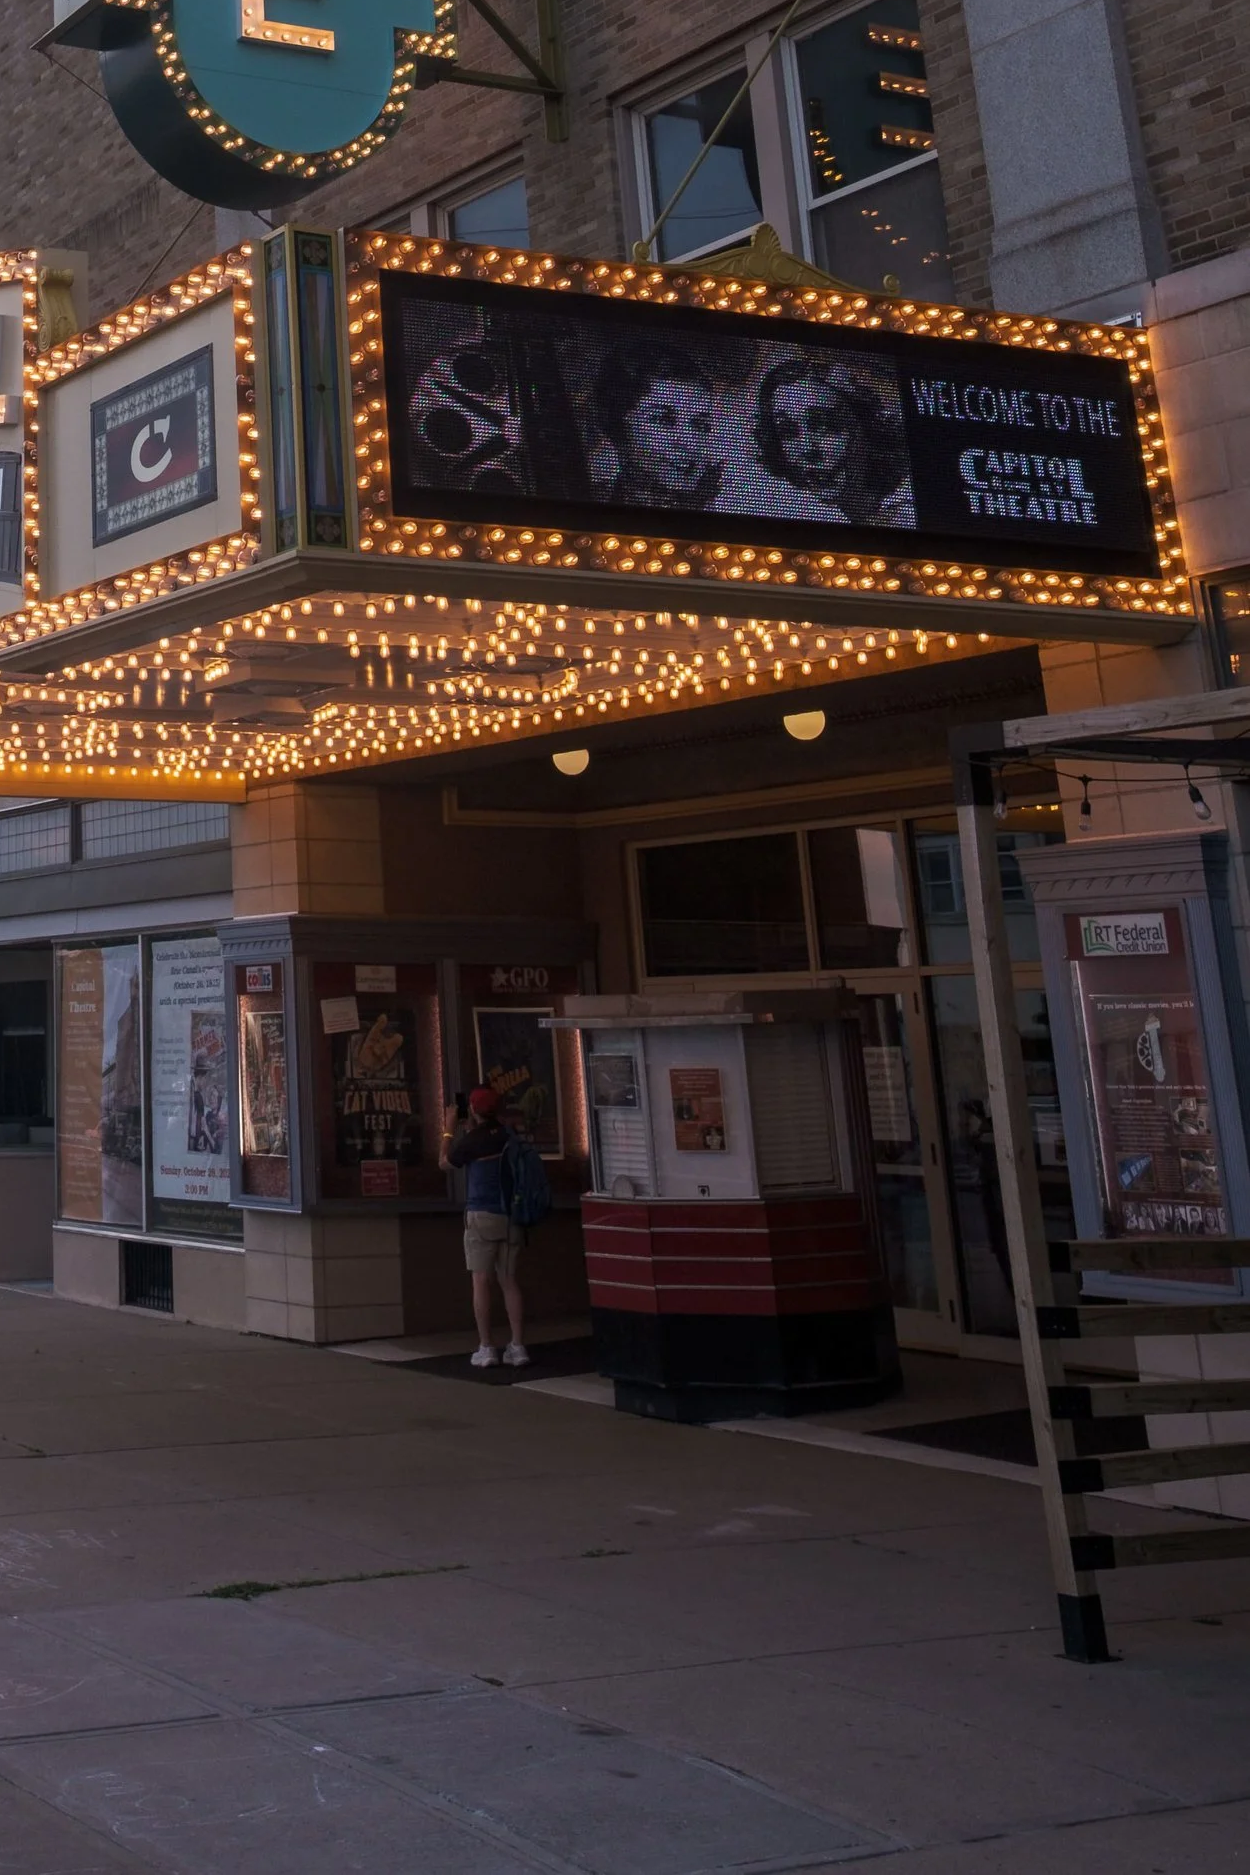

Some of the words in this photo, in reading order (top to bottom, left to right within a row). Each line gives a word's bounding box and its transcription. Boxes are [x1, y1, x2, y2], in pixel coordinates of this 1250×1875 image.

[911, 377, 1035, 427] WELCOME
[1036, 392, 1071, 431] TO
[1071, 396, 1122, 437] THE
[959, 448, 1095, 500] CAPITOL
[963, 490, 1098, 525] THEATRE
[1094, 925, 1111, 942] RT
[1114, 922, 1164, 942] Federal
[1116, 941, 1139, 953] Credit
[1142, 940, 1167, 952] Union
[510, 966, 549, 987] GPO
[343, 1090, 368, 1116] CAT
[371, 1089, 412, 1115] VIDEO
[364, 1114, 391, 1131] FEST
[184, 1166, 207, 1177] October
